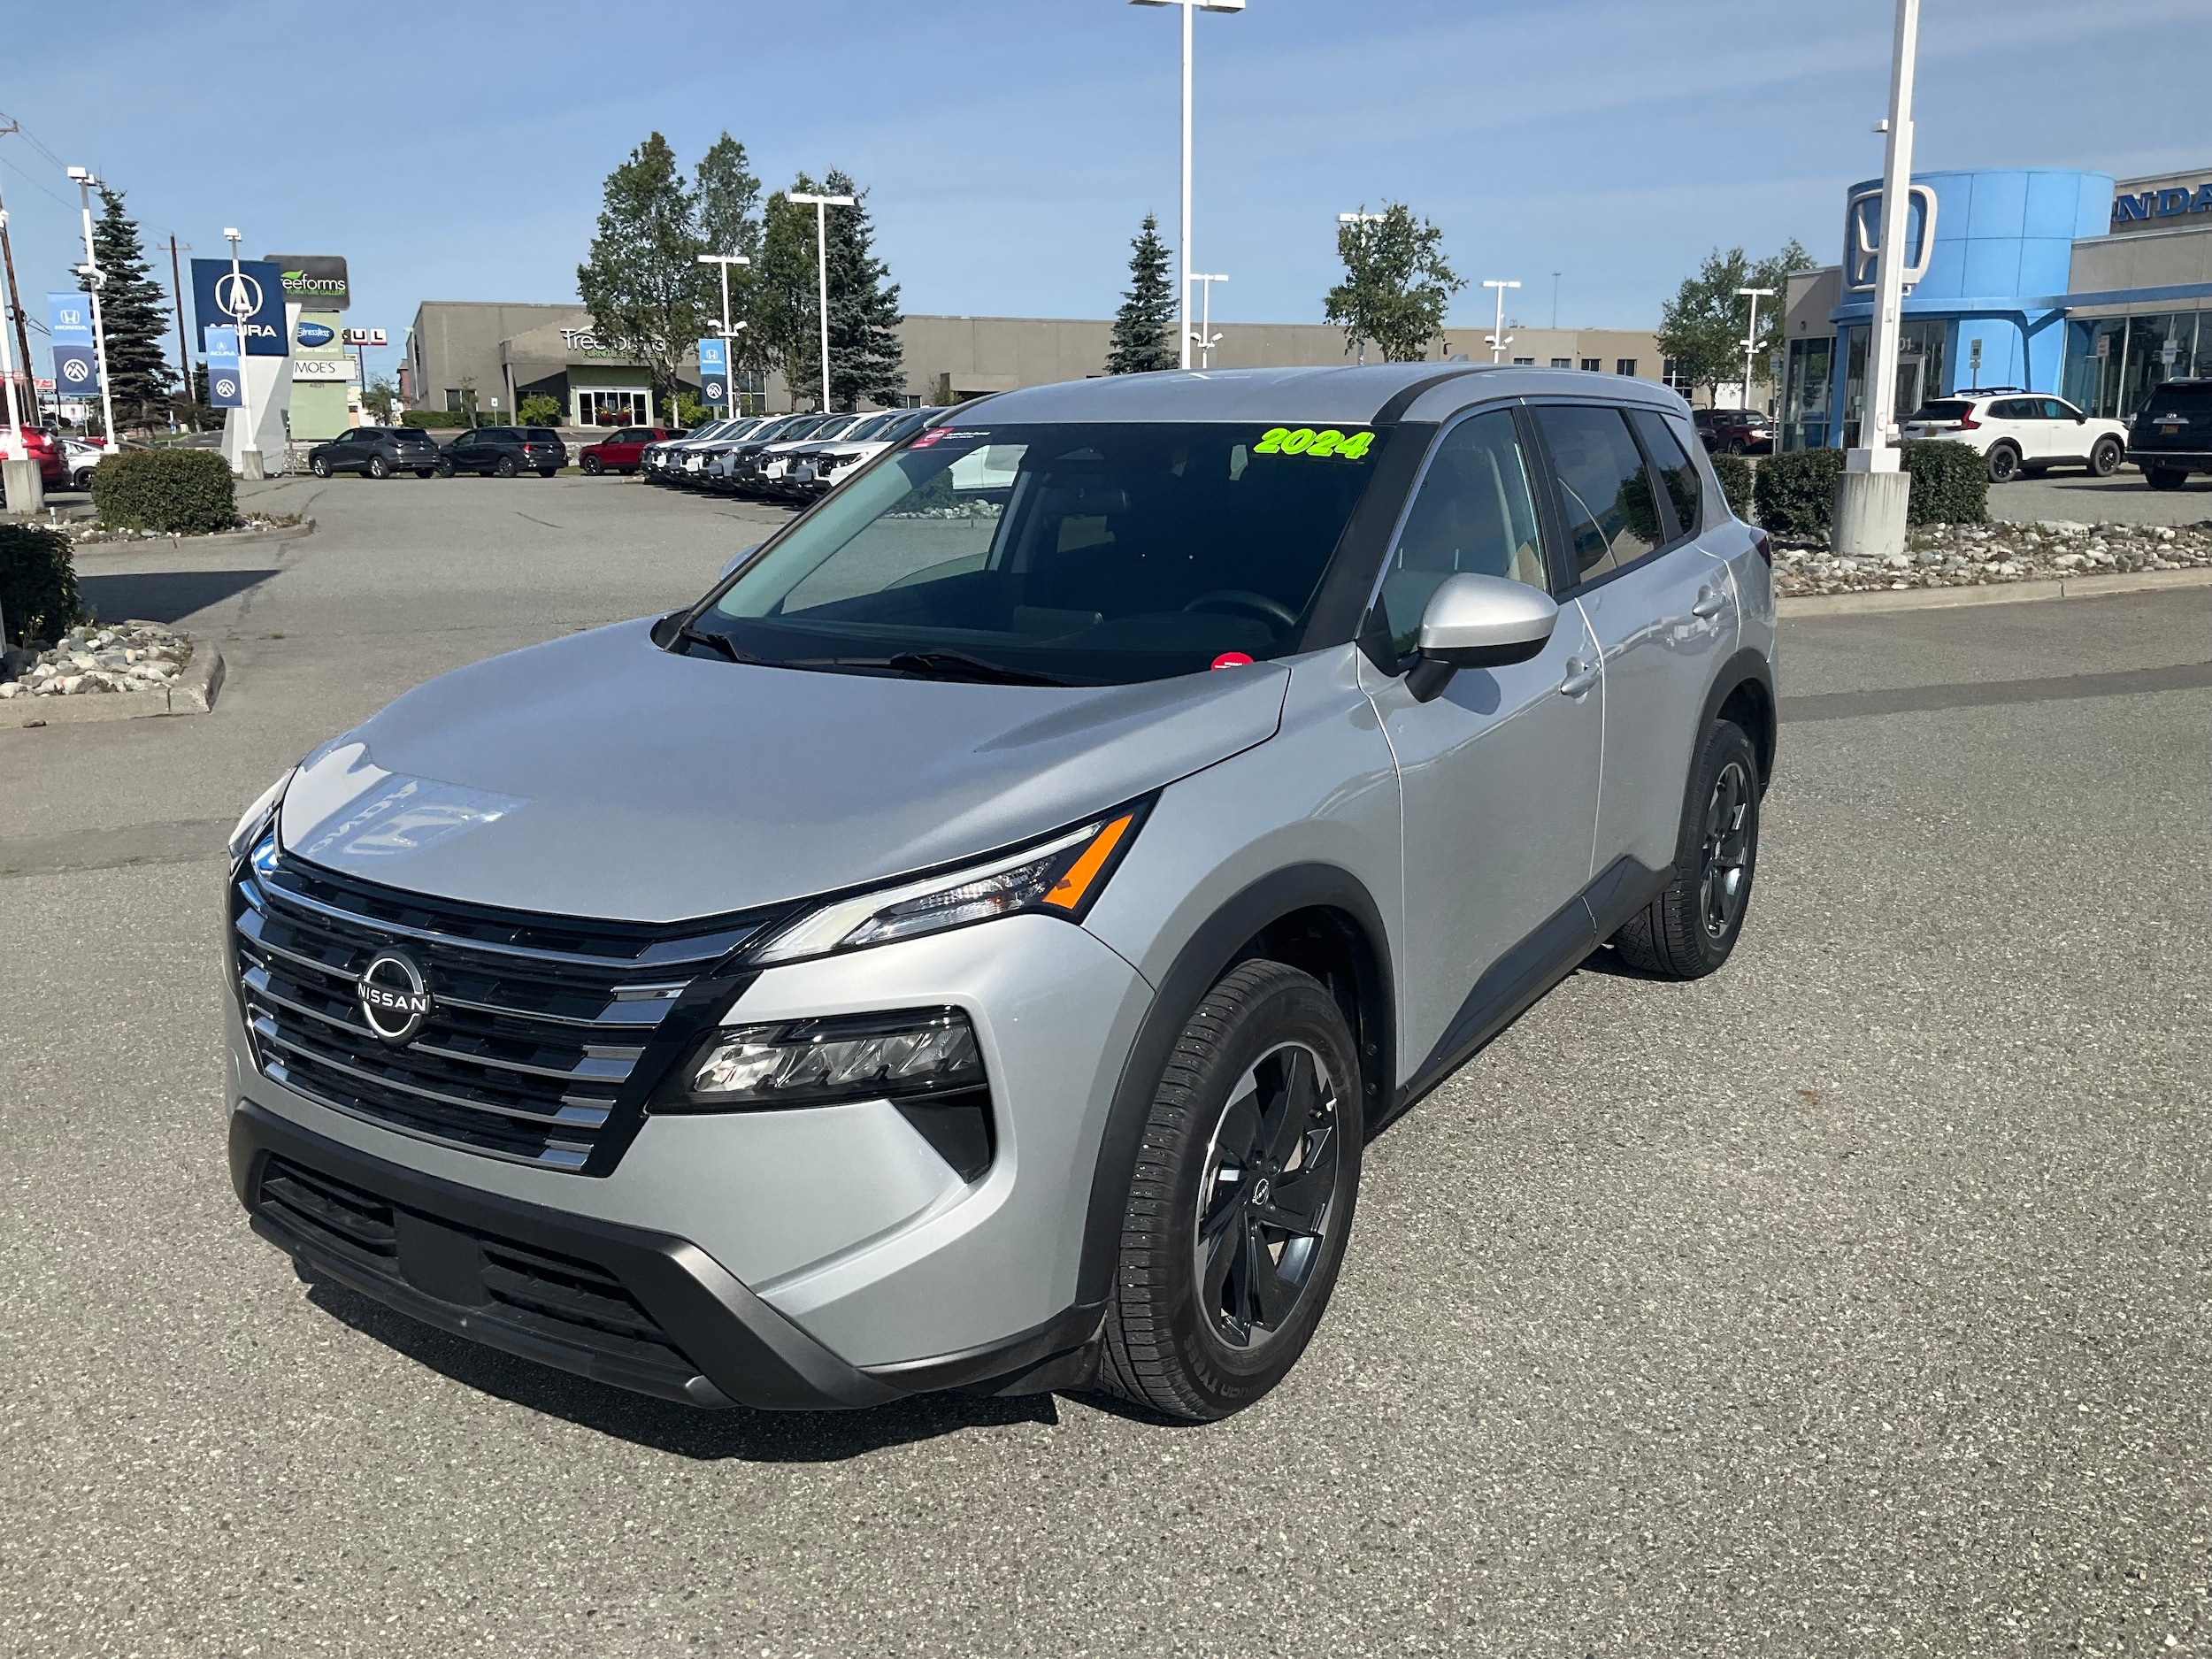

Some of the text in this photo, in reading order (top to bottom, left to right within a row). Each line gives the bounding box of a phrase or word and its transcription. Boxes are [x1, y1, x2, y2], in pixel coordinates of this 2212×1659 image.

[281, 273, 346, 290] eeforms
[210, 323, 277, 337] URA
[295, 361, 335, 373] MOE'S
[1253, 427, 1376, 460] 2024
[358, 982, 426, 1011] NISSAN
